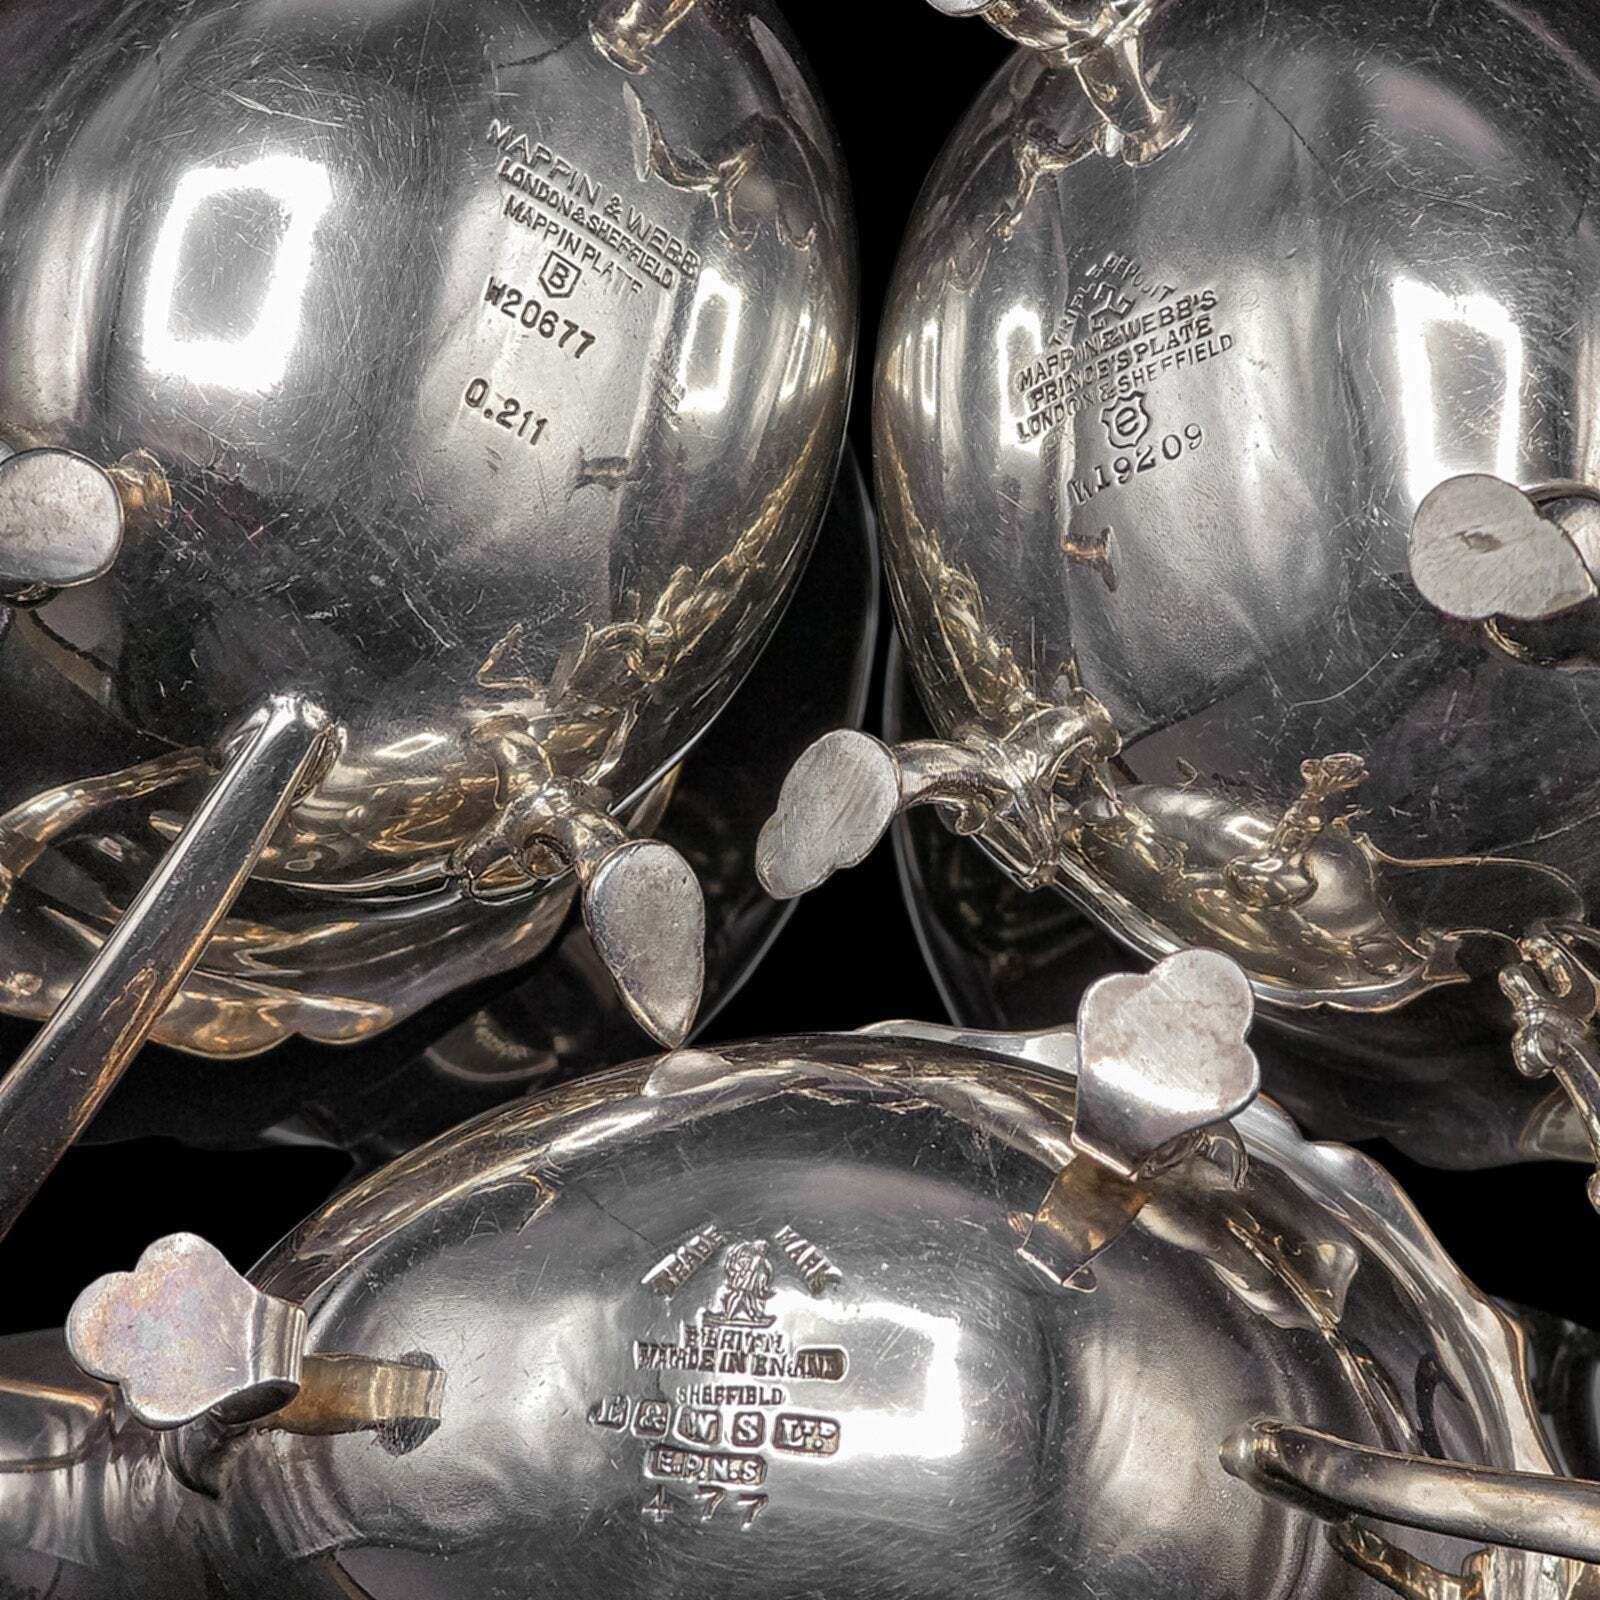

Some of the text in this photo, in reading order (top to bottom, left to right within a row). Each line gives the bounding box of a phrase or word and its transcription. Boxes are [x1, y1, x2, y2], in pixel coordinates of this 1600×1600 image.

[486, 118, 700, 281] MAPPIN & WEBB
[503, 194, 582, 255] MAPPIN
[546, 260, 571, 290] B
[484, 276, 596, 359] W20677
[464, 377, 549, 446] 0.211
[718, 1349, 746, 1374] IN
[676, 1384, 786, 1406] SHEFFIELD
[737, 1414, 760, 1442] S
